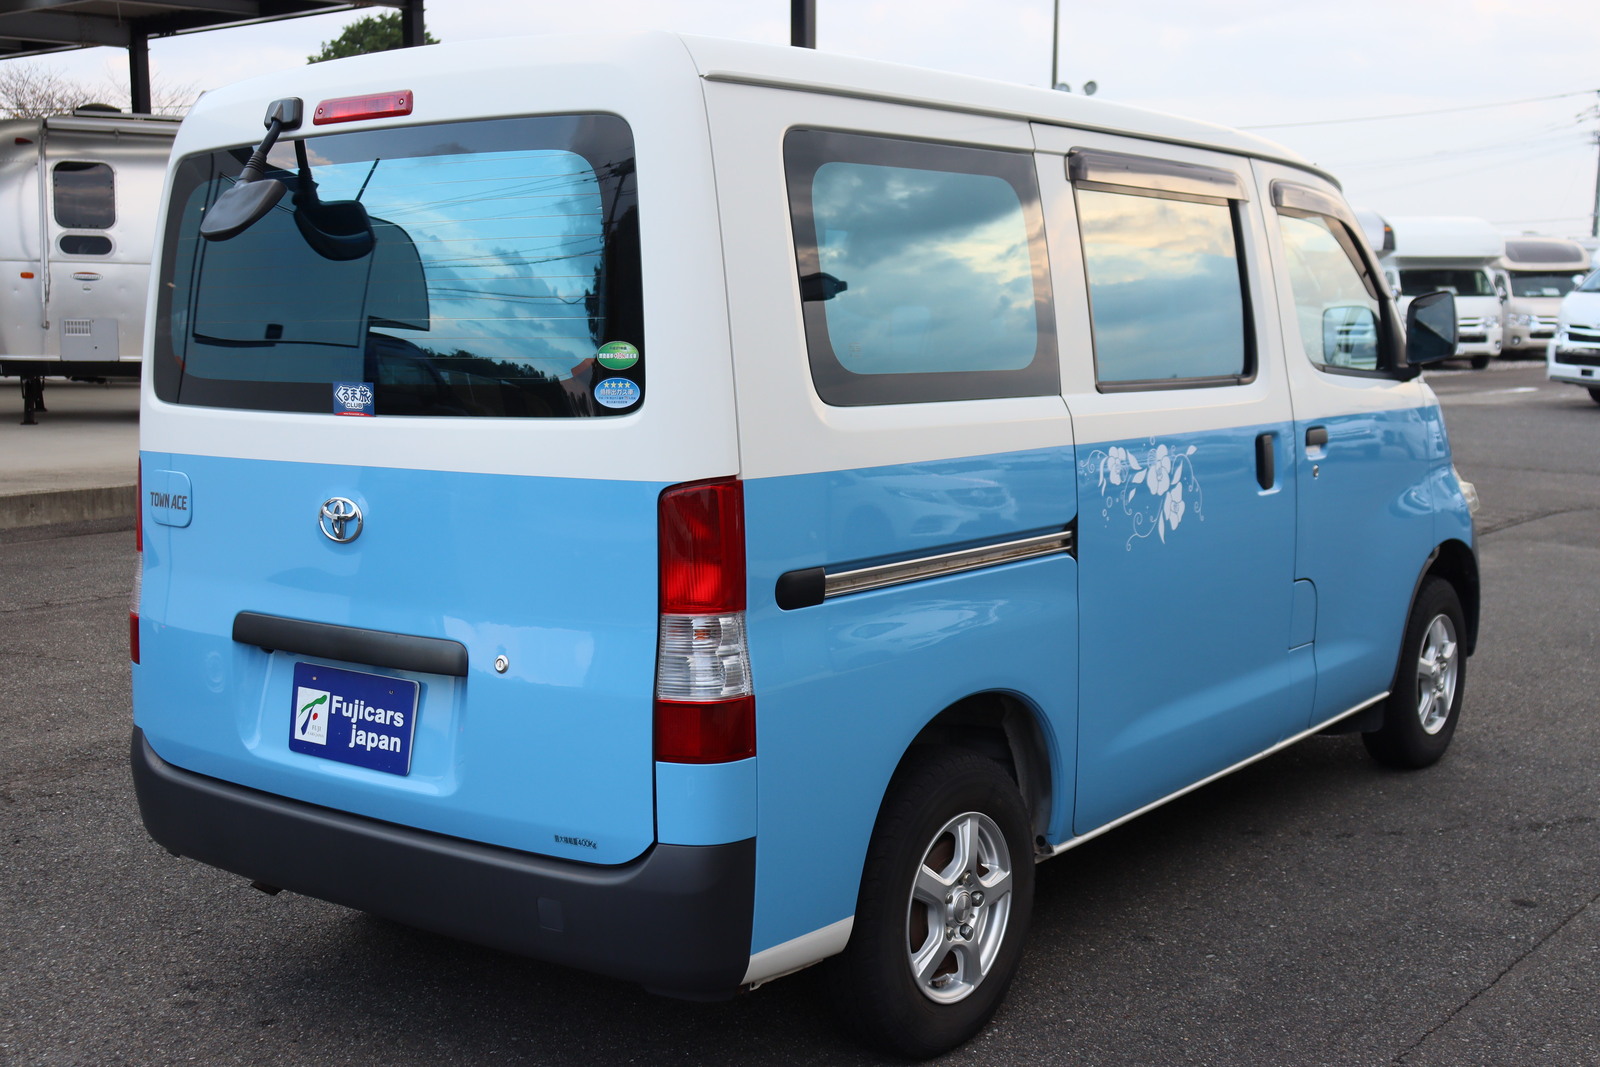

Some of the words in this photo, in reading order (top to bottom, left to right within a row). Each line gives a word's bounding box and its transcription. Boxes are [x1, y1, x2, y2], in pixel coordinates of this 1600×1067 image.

[150, 491, 170, 508] TOWN
[171, 495, 188, 511] ACE
[331, 695, 404, 727] Fujicars
[349, 724, 401, 752] japan
